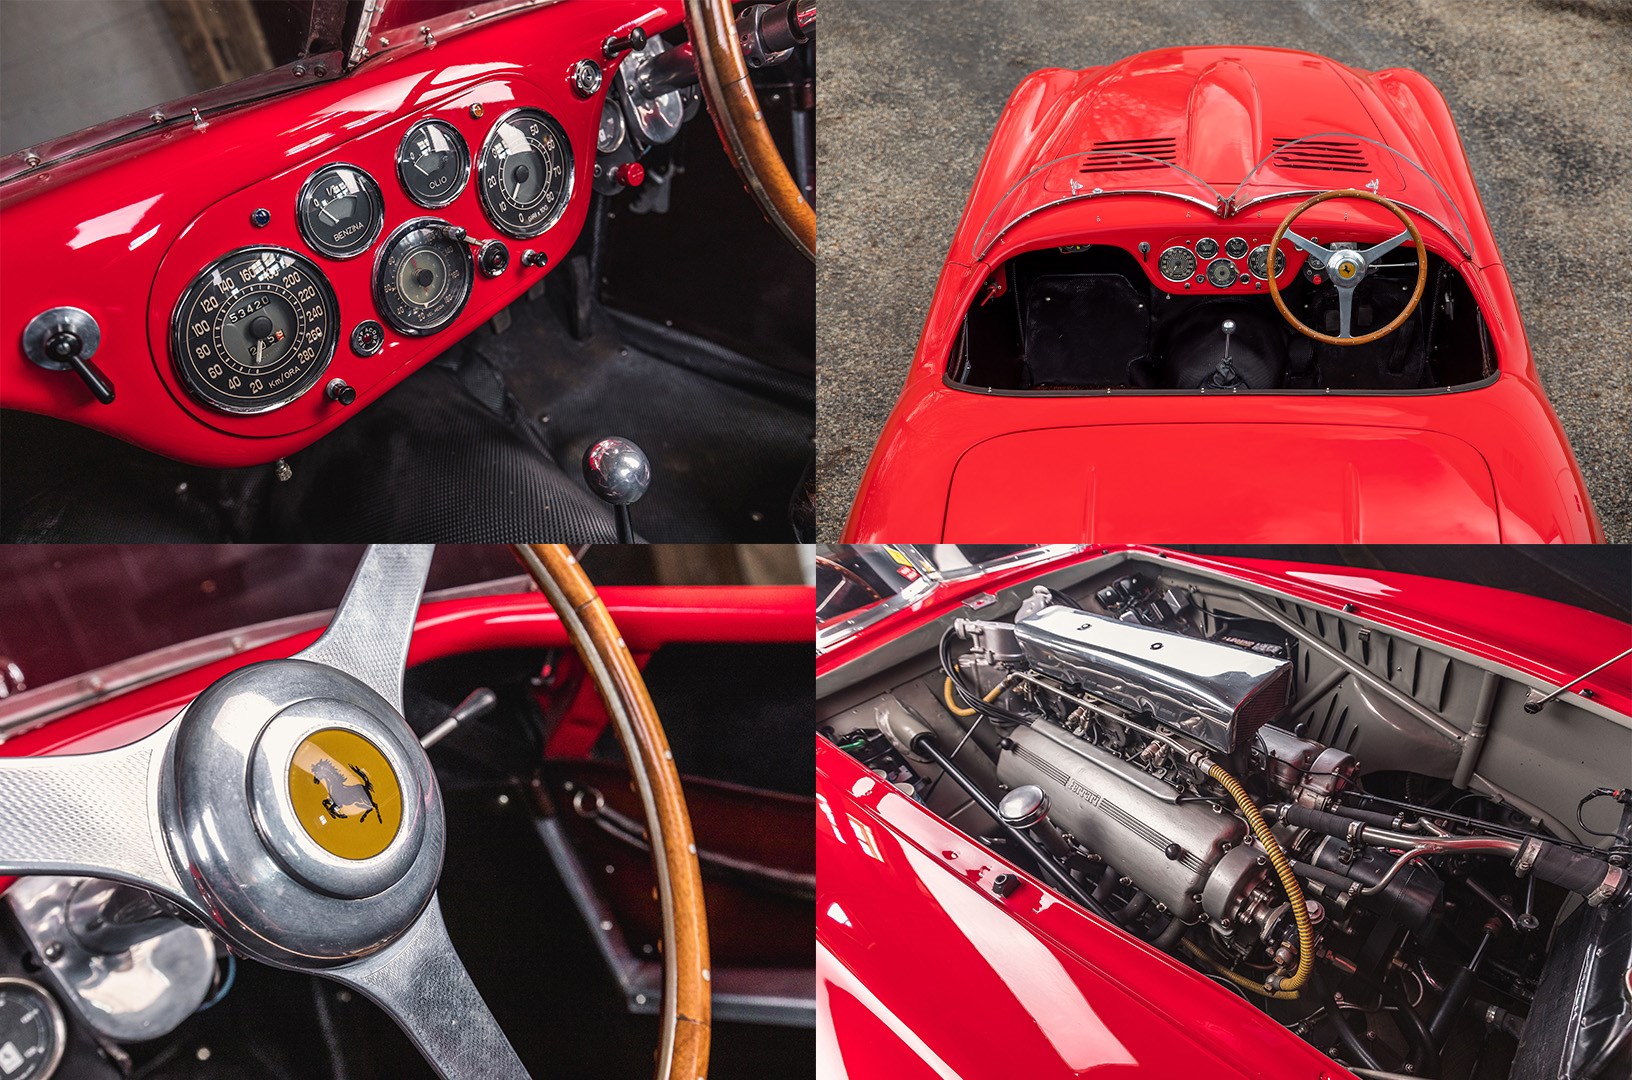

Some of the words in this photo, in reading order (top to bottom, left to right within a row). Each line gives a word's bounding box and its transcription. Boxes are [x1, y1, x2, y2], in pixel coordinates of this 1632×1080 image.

[529, 123, 539, 136] 50
[546, 139, 556, 151] 60
[553, 165, 561, 177] 70
[429, 176, 447, 190] OLIO
[487, 175, 497, 188] 20
[313, 198, 320, 207] 0
[499, 201, 507, 213] 10
[518, 213, 524, 223] 0
[333, 221, 364, 242] BENZINA
[239, 268, 257, 283] 160
[282, 271, 301, 289] 200
[218, 277, 235, 294] 140
[297, 285, 316, 303] 220
[200, 296, 219, 313] 120
[229, 295, 270, 323] 53420
[306, 305, 324, 322] 240
[191, 319, 210, 337] 100
[305, 326, 323, 344] 260
[195, 343, 211, 360] 80
[297, 347, 315, 365] 280
[207, 363, 223, 380] 60
[268, 366, 301, 389] Km/ORA
[228, 375, 242, 391] 40
[249, 378, 264, 394] 20
[1068, 778, 1101, 807] Ferrari
